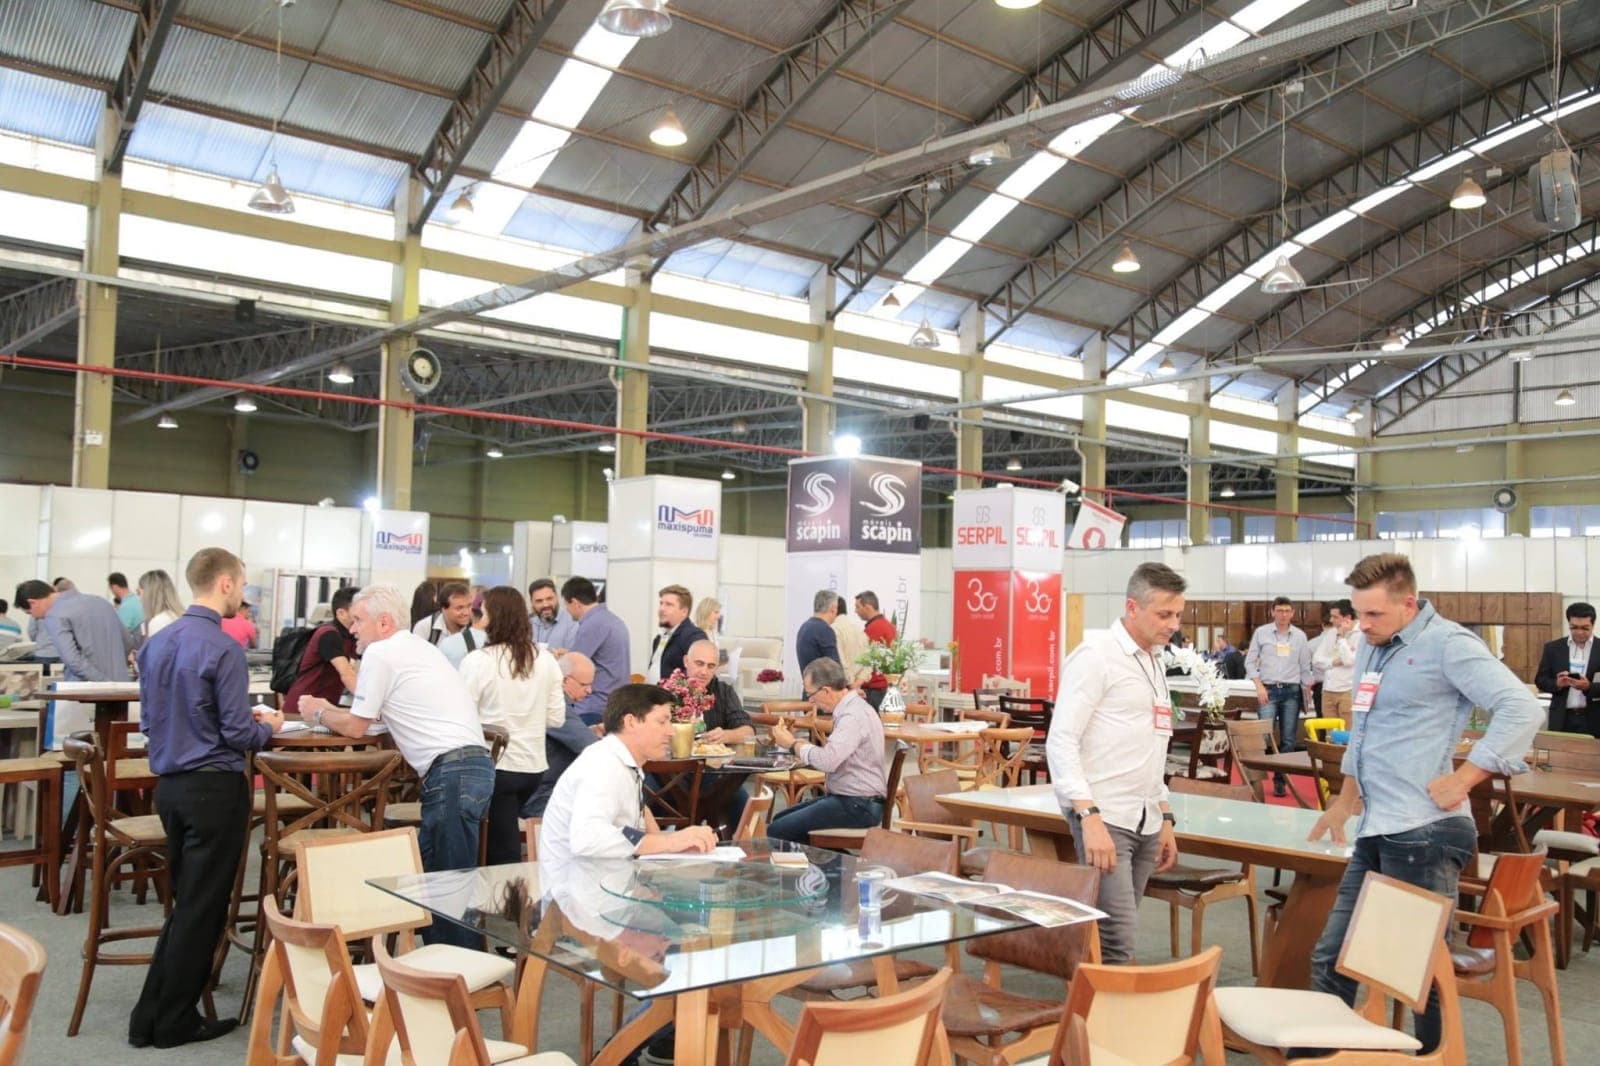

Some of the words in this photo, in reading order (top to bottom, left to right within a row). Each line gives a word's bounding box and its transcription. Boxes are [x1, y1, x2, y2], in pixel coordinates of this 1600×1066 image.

[657, 522, 713, 535] maxispuma
[796, 519, 841, 543] scapin
[861, 521, 912, 544] scapin
[957, 526, 1007, 545] SERPIL
[1016, 526, 1059, 548] SEPIL
